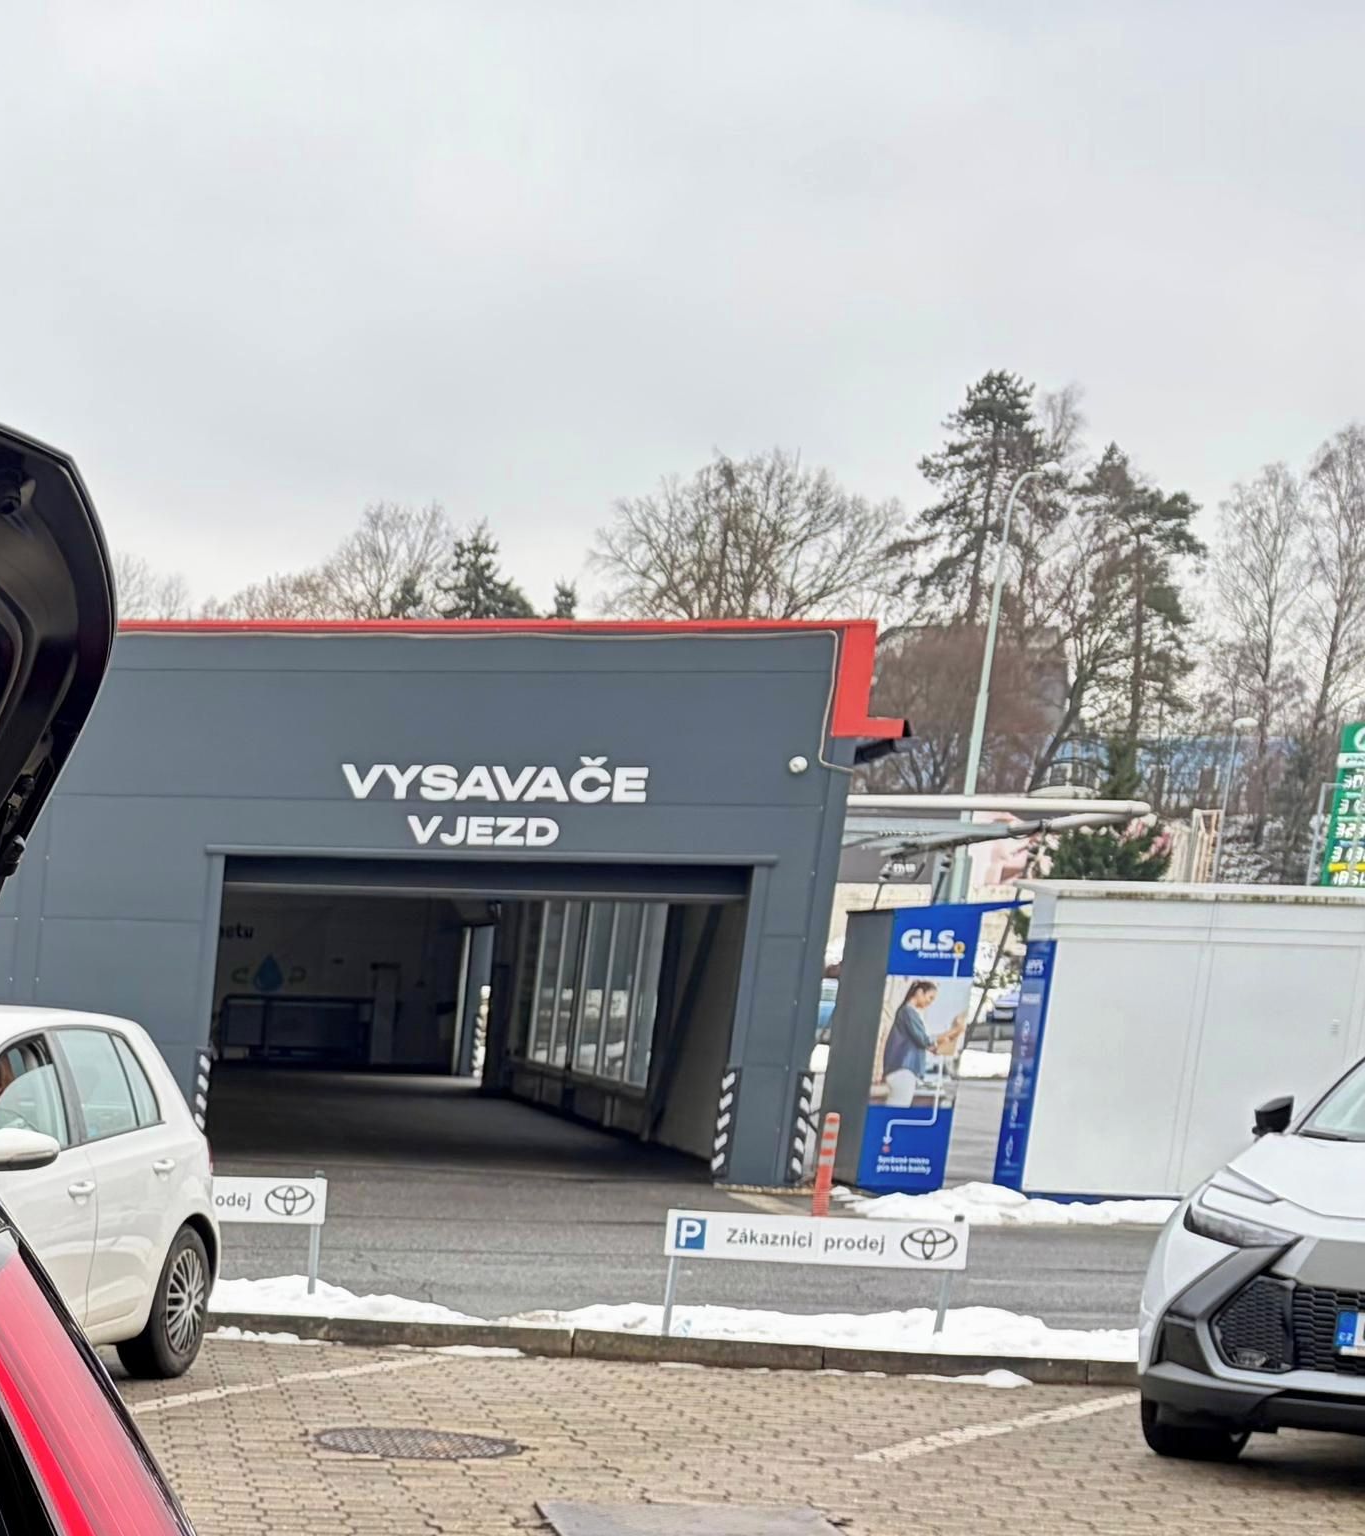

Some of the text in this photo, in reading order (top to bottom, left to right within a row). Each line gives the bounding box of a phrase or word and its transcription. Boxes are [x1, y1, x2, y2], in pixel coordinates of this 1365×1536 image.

[341, 756, 649, 803] VYSAVAČE
[407, 815, 559, 847] VJEZD
[679, 1220, 701, 1247] P
[824, 1235, 886, 1255] prodej
